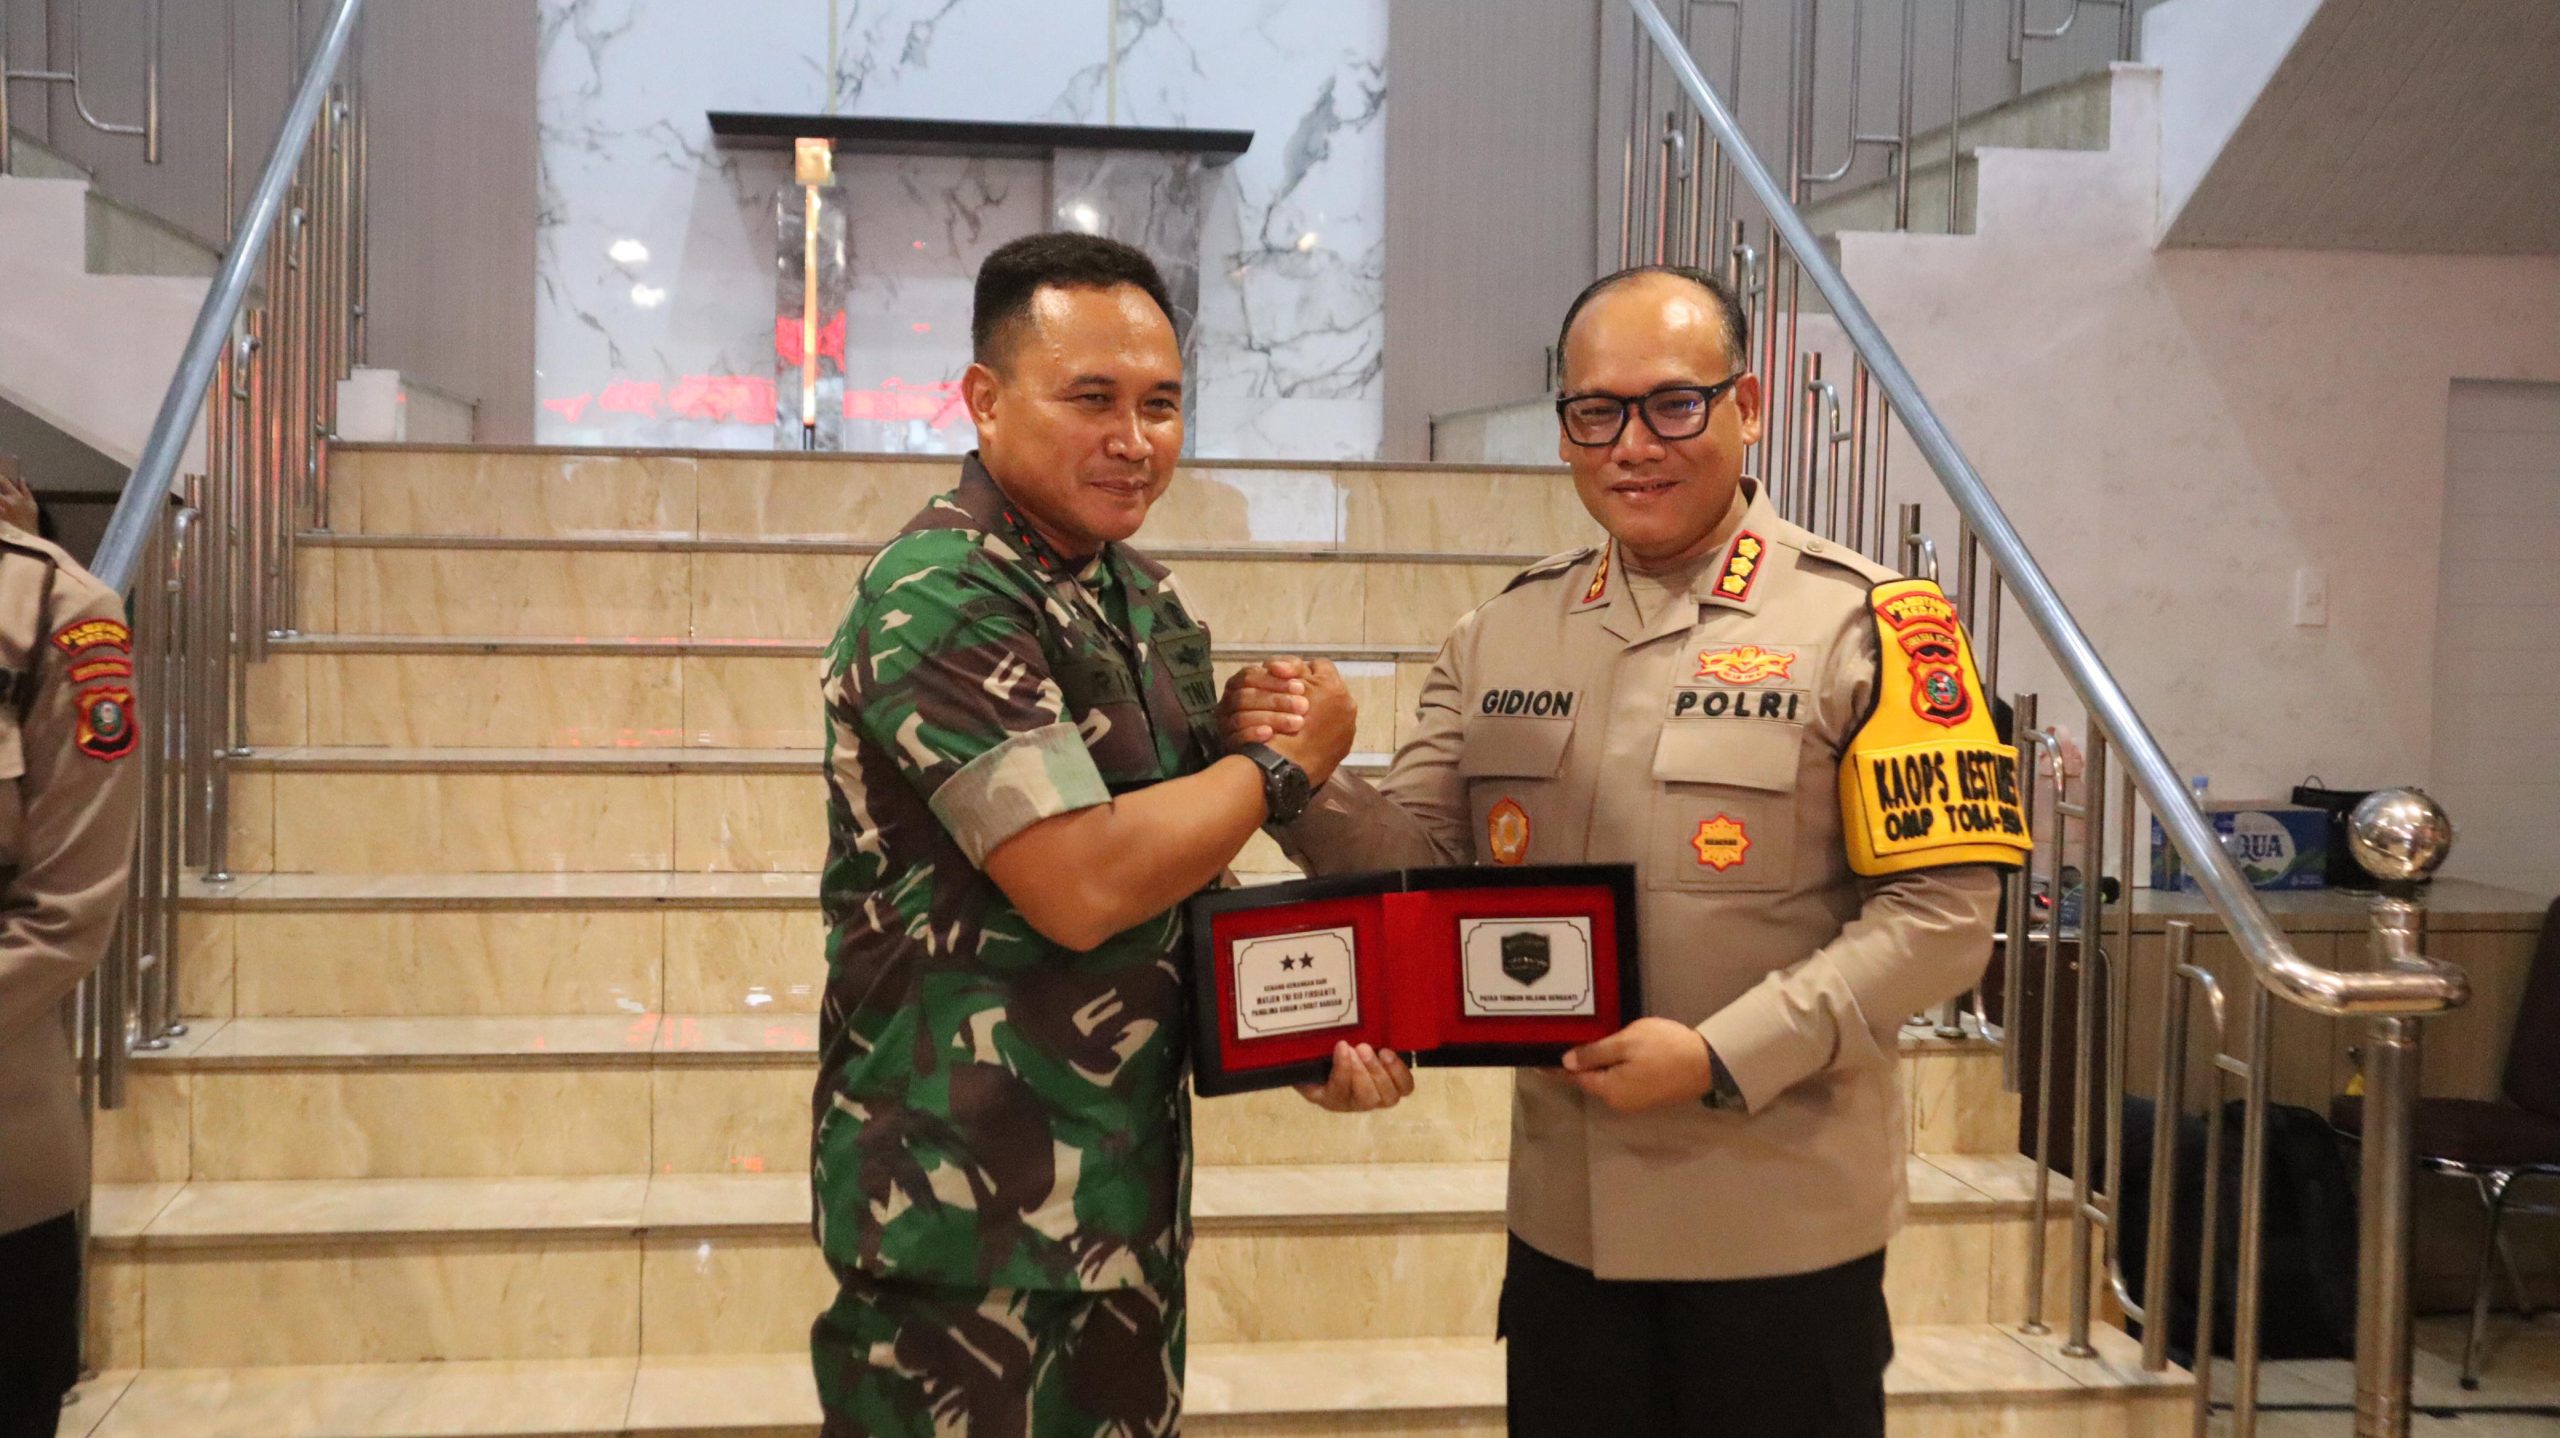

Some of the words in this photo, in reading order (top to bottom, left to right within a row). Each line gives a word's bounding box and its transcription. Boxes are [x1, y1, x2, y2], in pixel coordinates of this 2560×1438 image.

[1482, 689, 1574, 717] GIDION
[1675, 691, 1798, 720] POLRI
[1873, 751, 1949, 812] KAOPS
[1885, 808, 1934, 841] OMP
[2237, 833, 2284, 862] QUA
